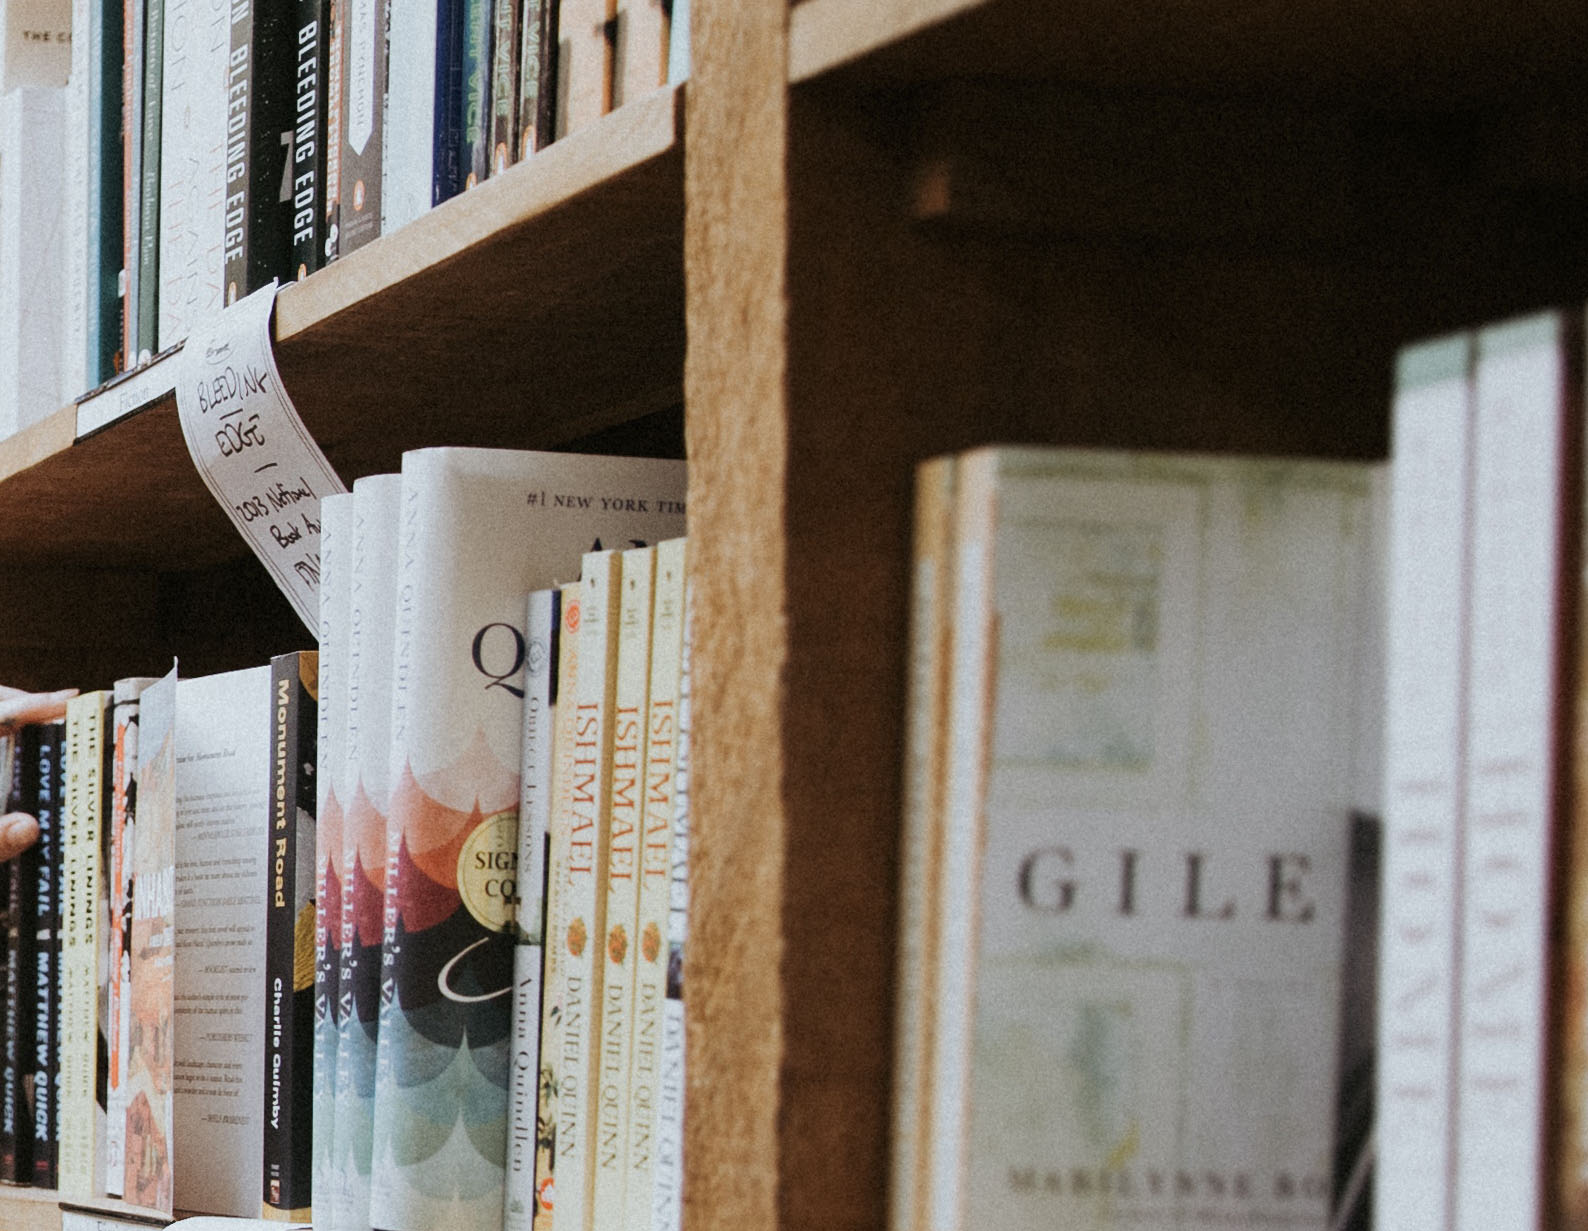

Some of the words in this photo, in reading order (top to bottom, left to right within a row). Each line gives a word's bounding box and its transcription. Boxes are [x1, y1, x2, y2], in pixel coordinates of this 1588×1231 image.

[295, 20, 317, 164] BLEEDING
[496, 40, 512, 117] VICE
[524, 20, 540, 100] VICE
[226, 44, 249, 184] BLEEDING
[466, 72, 482, 145] VICE
[224, 192, 245, 265] EDGE
[293, 170, 314, 247] EDGE
[216, 414, 265, 457] EDGE
[236, 494, 270, 524] 2013
[553, 494, 591, 509] NEW
[600, 496, 648, 512] YORK
[71, 721, 80, 758] THE
[88, 714, 97, 753] THE
[275, 679, 290, 831] Monument
[38, 744, 52, 801] LOVE
[69, 773, 79, 847] SILVER
[86, 767, 96, 843] SILVER
[570, 703, 599, 886] ISHMAEL
[608, 707, 638, 894] ISHMAEL
[642, 701, 674, 891] ISHMAEL
[38, 809, 52, 861] MAY
[275, 837, 288, 908] Road
[36, 866, 51, 917] FAIL
[67, 858, 78, 948] LININGS
[84, 854, 94, 945] LININGS
[1017, 844, 1322, 926] GILE
[34, 951, 50, 1068] MATTHEW
[272, 976, 284, 1049] Charlie
[518, 978, 532, 1039] Anna
[561, 976, 583, 1065] DANIEL
[605, 983, 624, 1074] DANIEL
[636, 982, 657, 1075] DANIEL
[33, 1071, 49, 1143] QUICK
[269, 1053, 283, 1131] Quimby
[513, 1050, 530, 1172] Quindlen
[560, 1074, 579, 1158] QUINN
[601, 1083, 620, 1171] QUINN
[632, 1083, 653, 1171] QUINN
[1005, 1160, 1252, 1203] MARILYNNE
